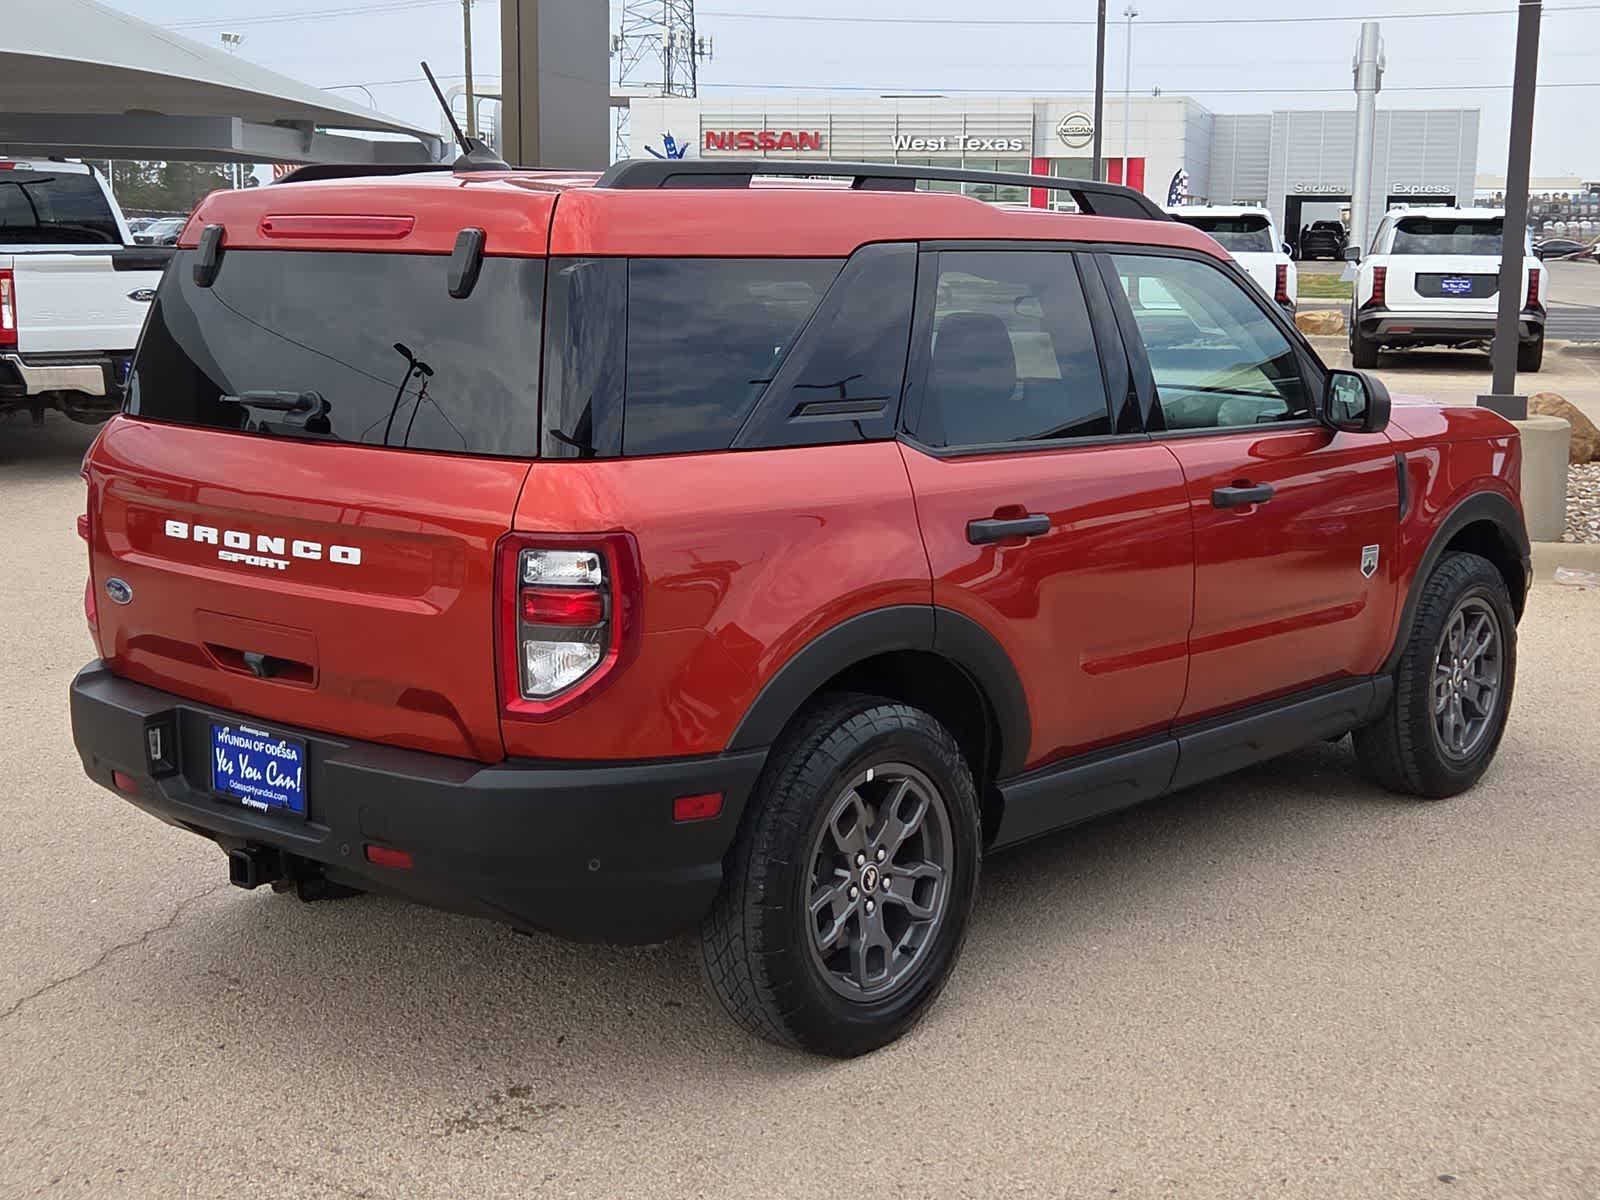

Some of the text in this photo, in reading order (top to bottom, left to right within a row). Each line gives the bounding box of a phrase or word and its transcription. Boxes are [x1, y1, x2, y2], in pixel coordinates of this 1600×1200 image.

[705, 131, 820, 150] NISSAN
[891, 135, 1023, 151] West Texas
[1295, 182, 1347, 194] Service
[1392, 183, 1451, 196] Express
[165, 519, 361, 565] BRONCO
[218, 550, 290, 570] SPORT
[217, 729, 297, 761] HYUNDAI OF ODESSA
[215, 747, 302, 793] Yes You Can!
